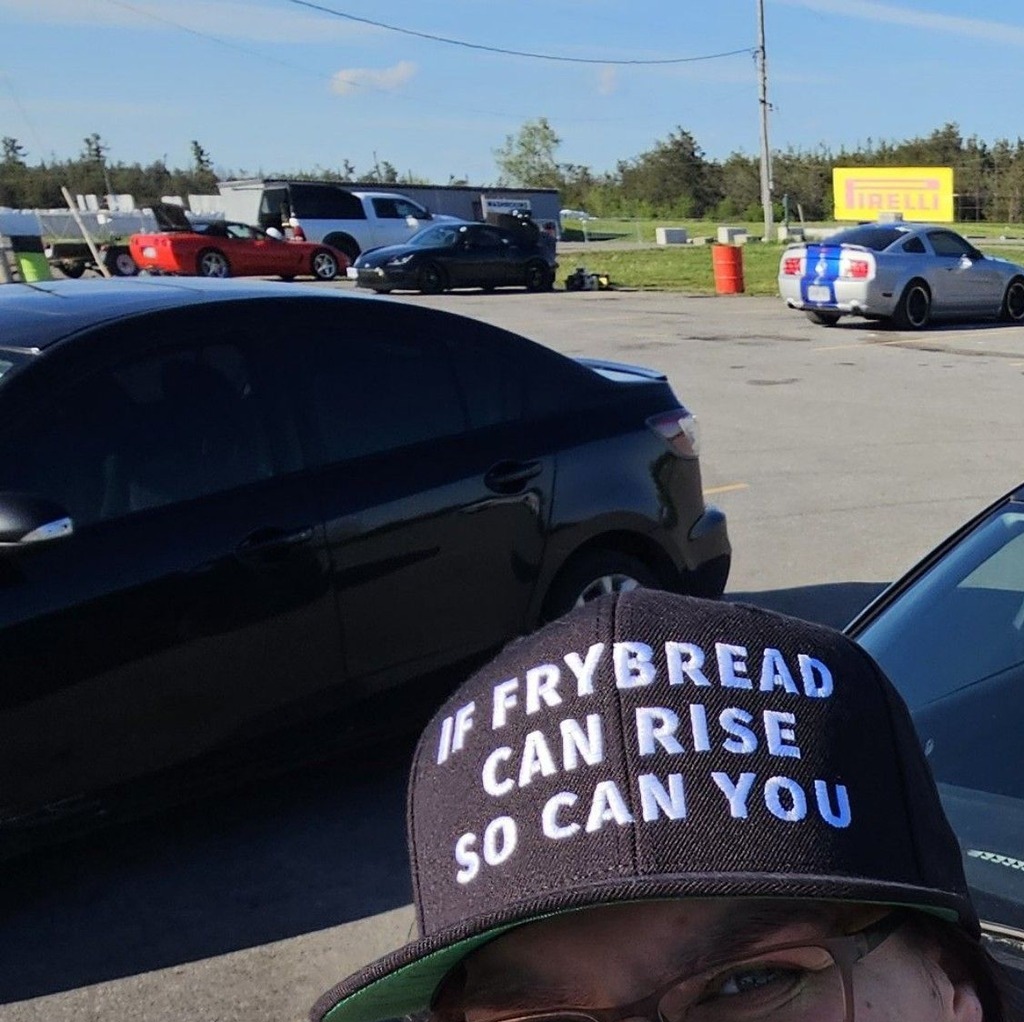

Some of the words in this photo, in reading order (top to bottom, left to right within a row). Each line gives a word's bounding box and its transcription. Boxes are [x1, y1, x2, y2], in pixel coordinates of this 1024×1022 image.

[844, 178, 940, 211] PIRELLI
[437, 701, 475, 765] IF
[492, 641, 834, 730] FRYBREAD
[482, 713, 604, 797] CAN
[635, 704, 802, 760] RISE
[455, 815, 517, 884] SO
[542, 773, 687, 839] CAN
[711, 771, 852, 829] YOU
